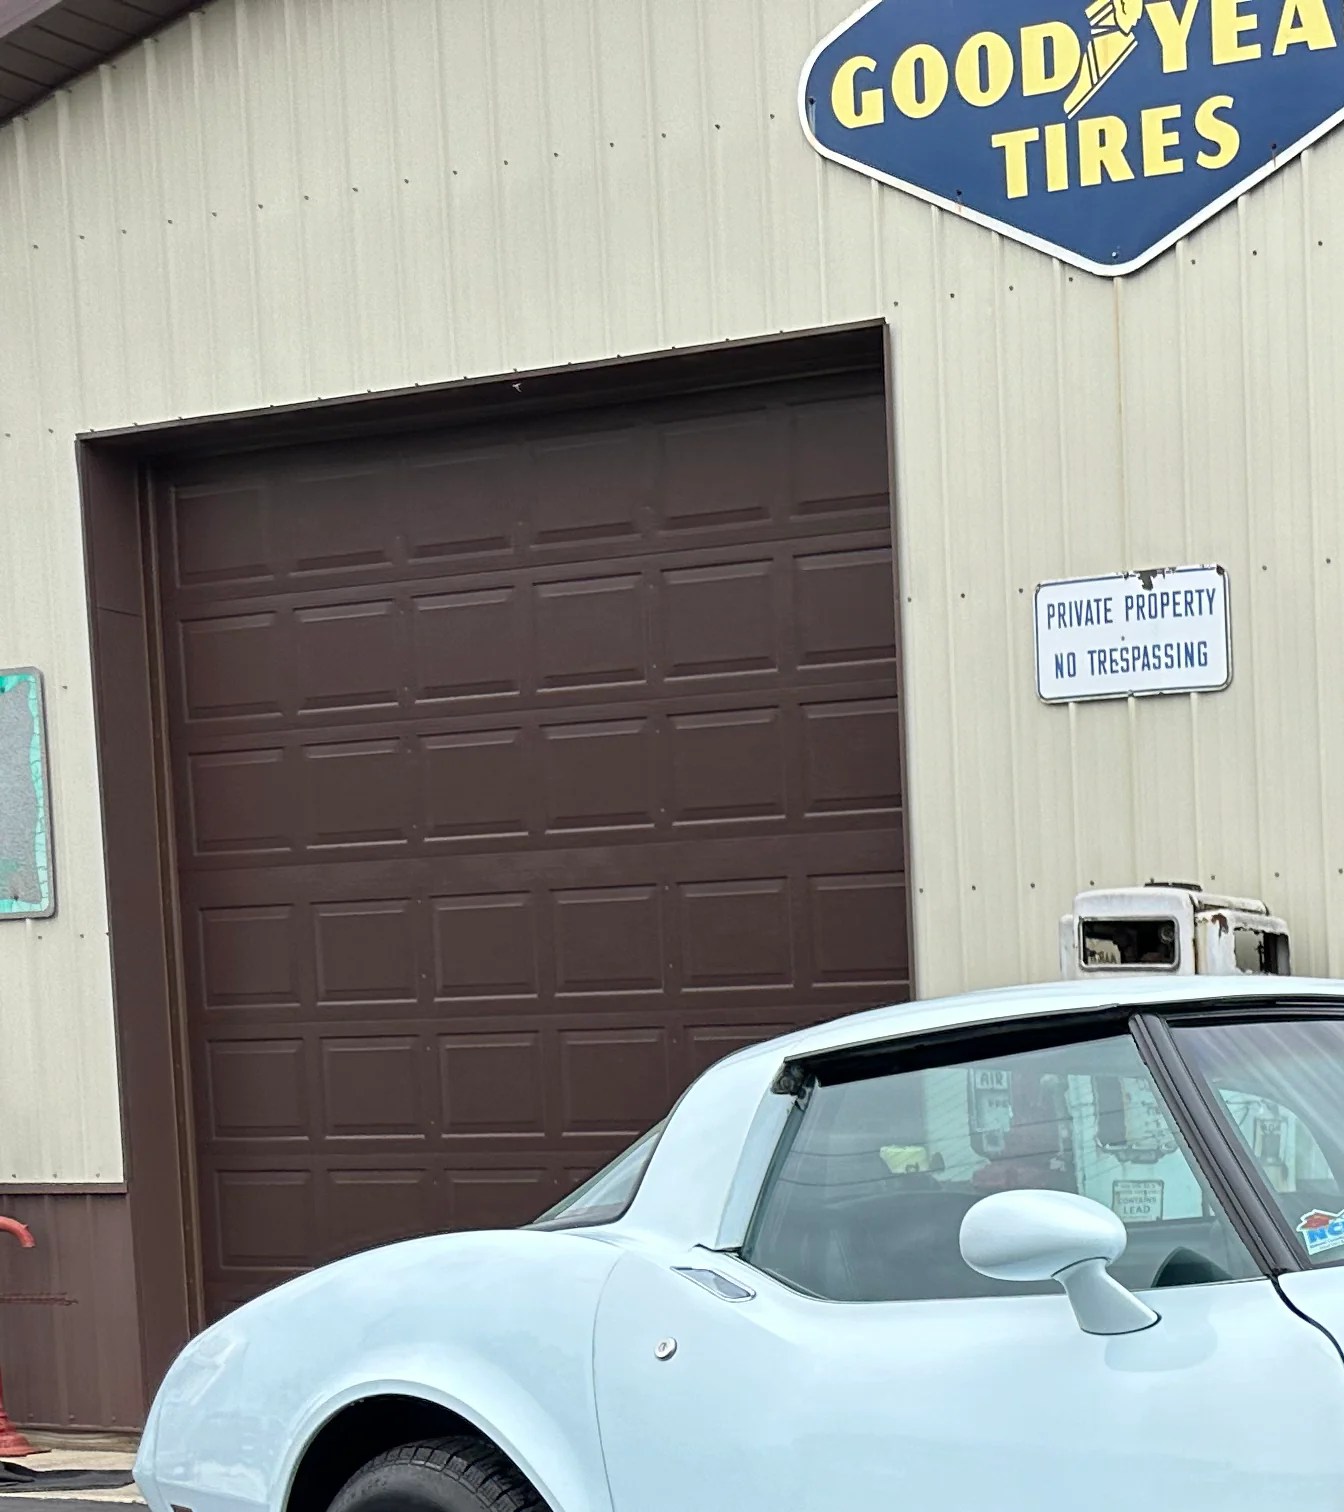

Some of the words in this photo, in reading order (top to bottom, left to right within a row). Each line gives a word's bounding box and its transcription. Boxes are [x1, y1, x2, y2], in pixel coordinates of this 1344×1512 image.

[991, 95, 1240, 200] TIRES
[1047, 597, 1113, 630] PRIVATE
[1125, 588, 1216, 622] PROPERTY
[1055, 652, 1076, 679] NO
[1087, 641, 1208, 676] TRESPASSING
[1123, 1205, 1151, 1214] LEAD
